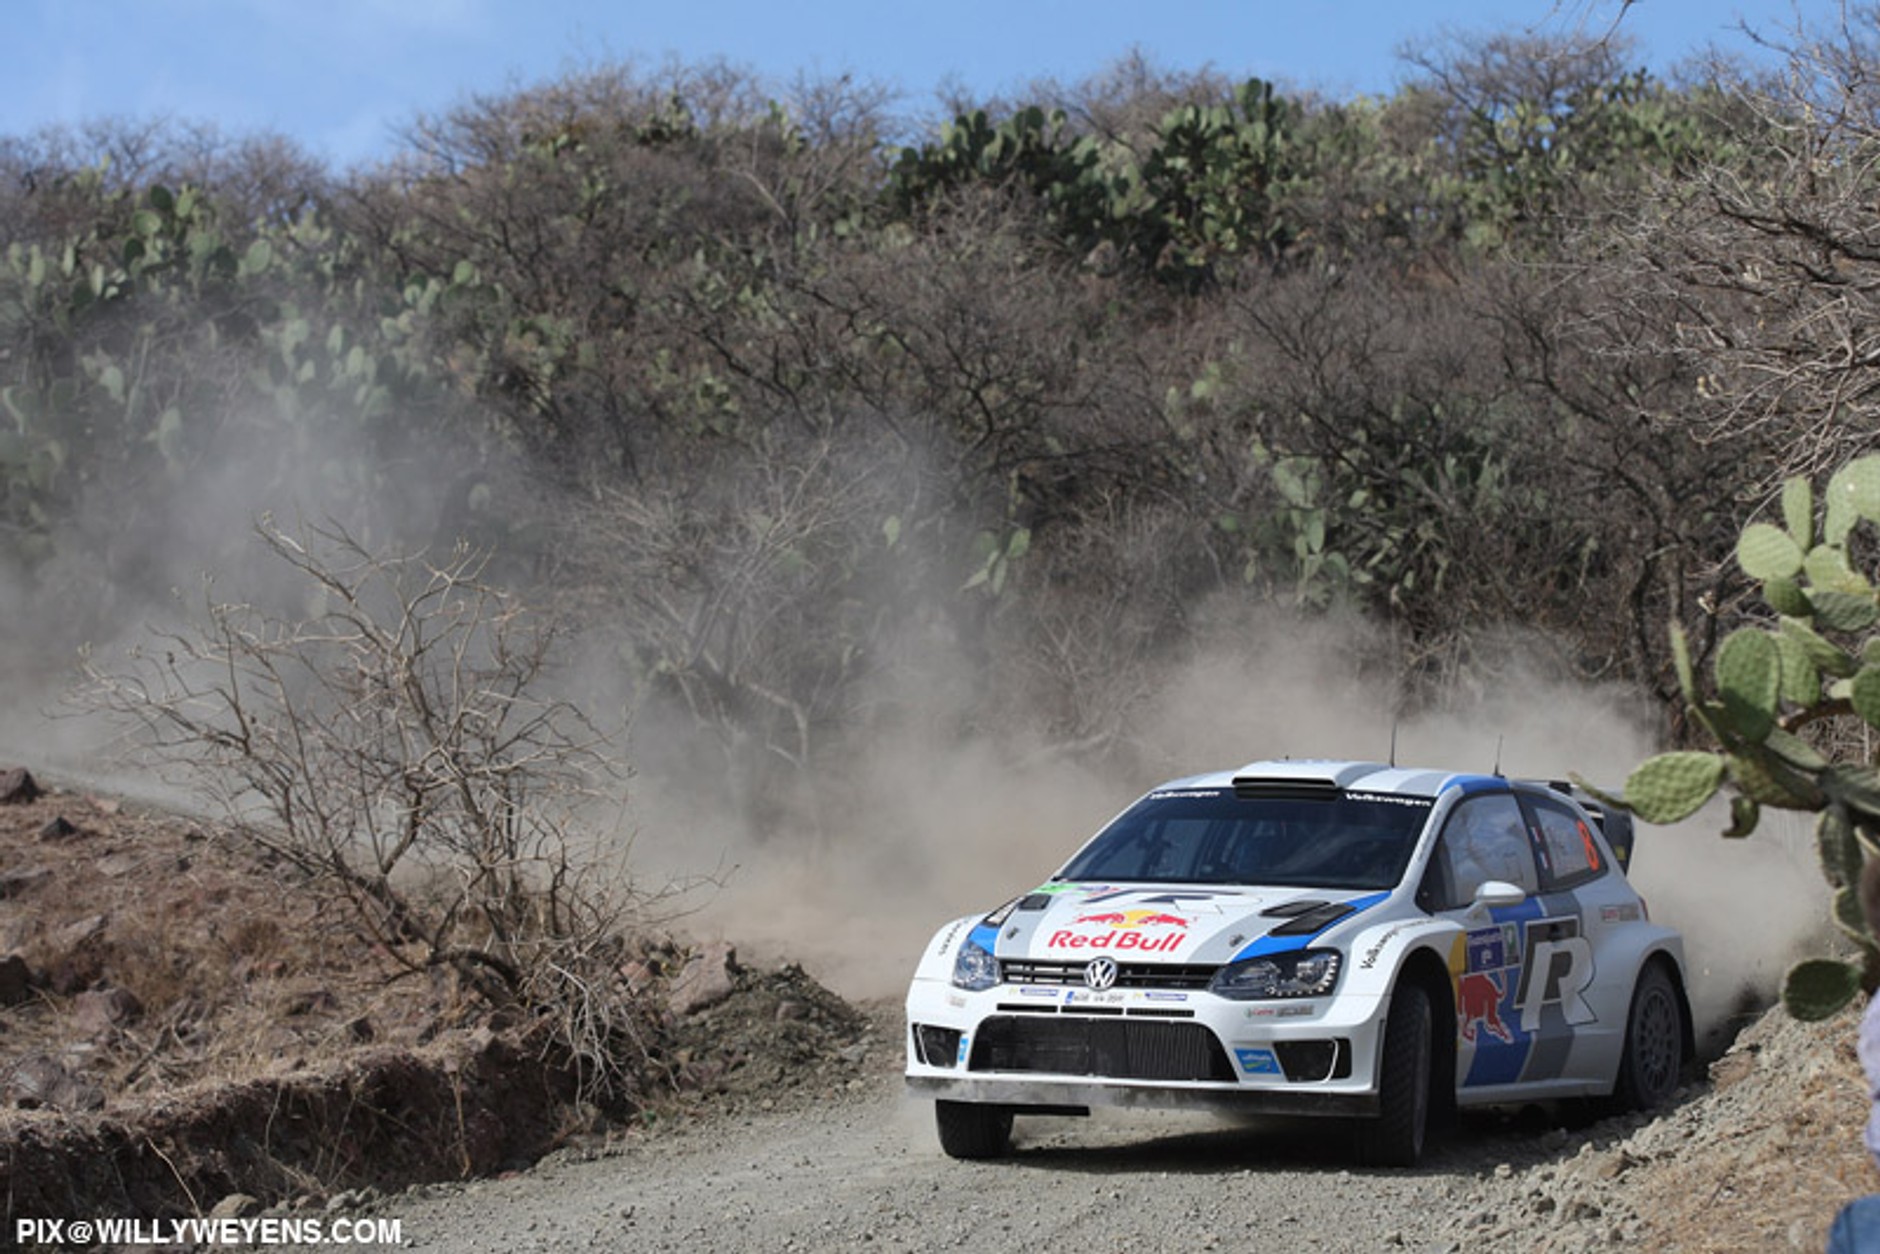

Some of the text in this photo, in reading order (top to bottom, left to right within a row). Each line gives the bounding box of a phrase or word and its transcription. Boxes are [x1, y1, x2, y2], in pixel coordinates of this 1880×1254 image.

[1346, 792, 1431, 807] Volkswagen
[1048, 930, 1186, 952] Red Bull
